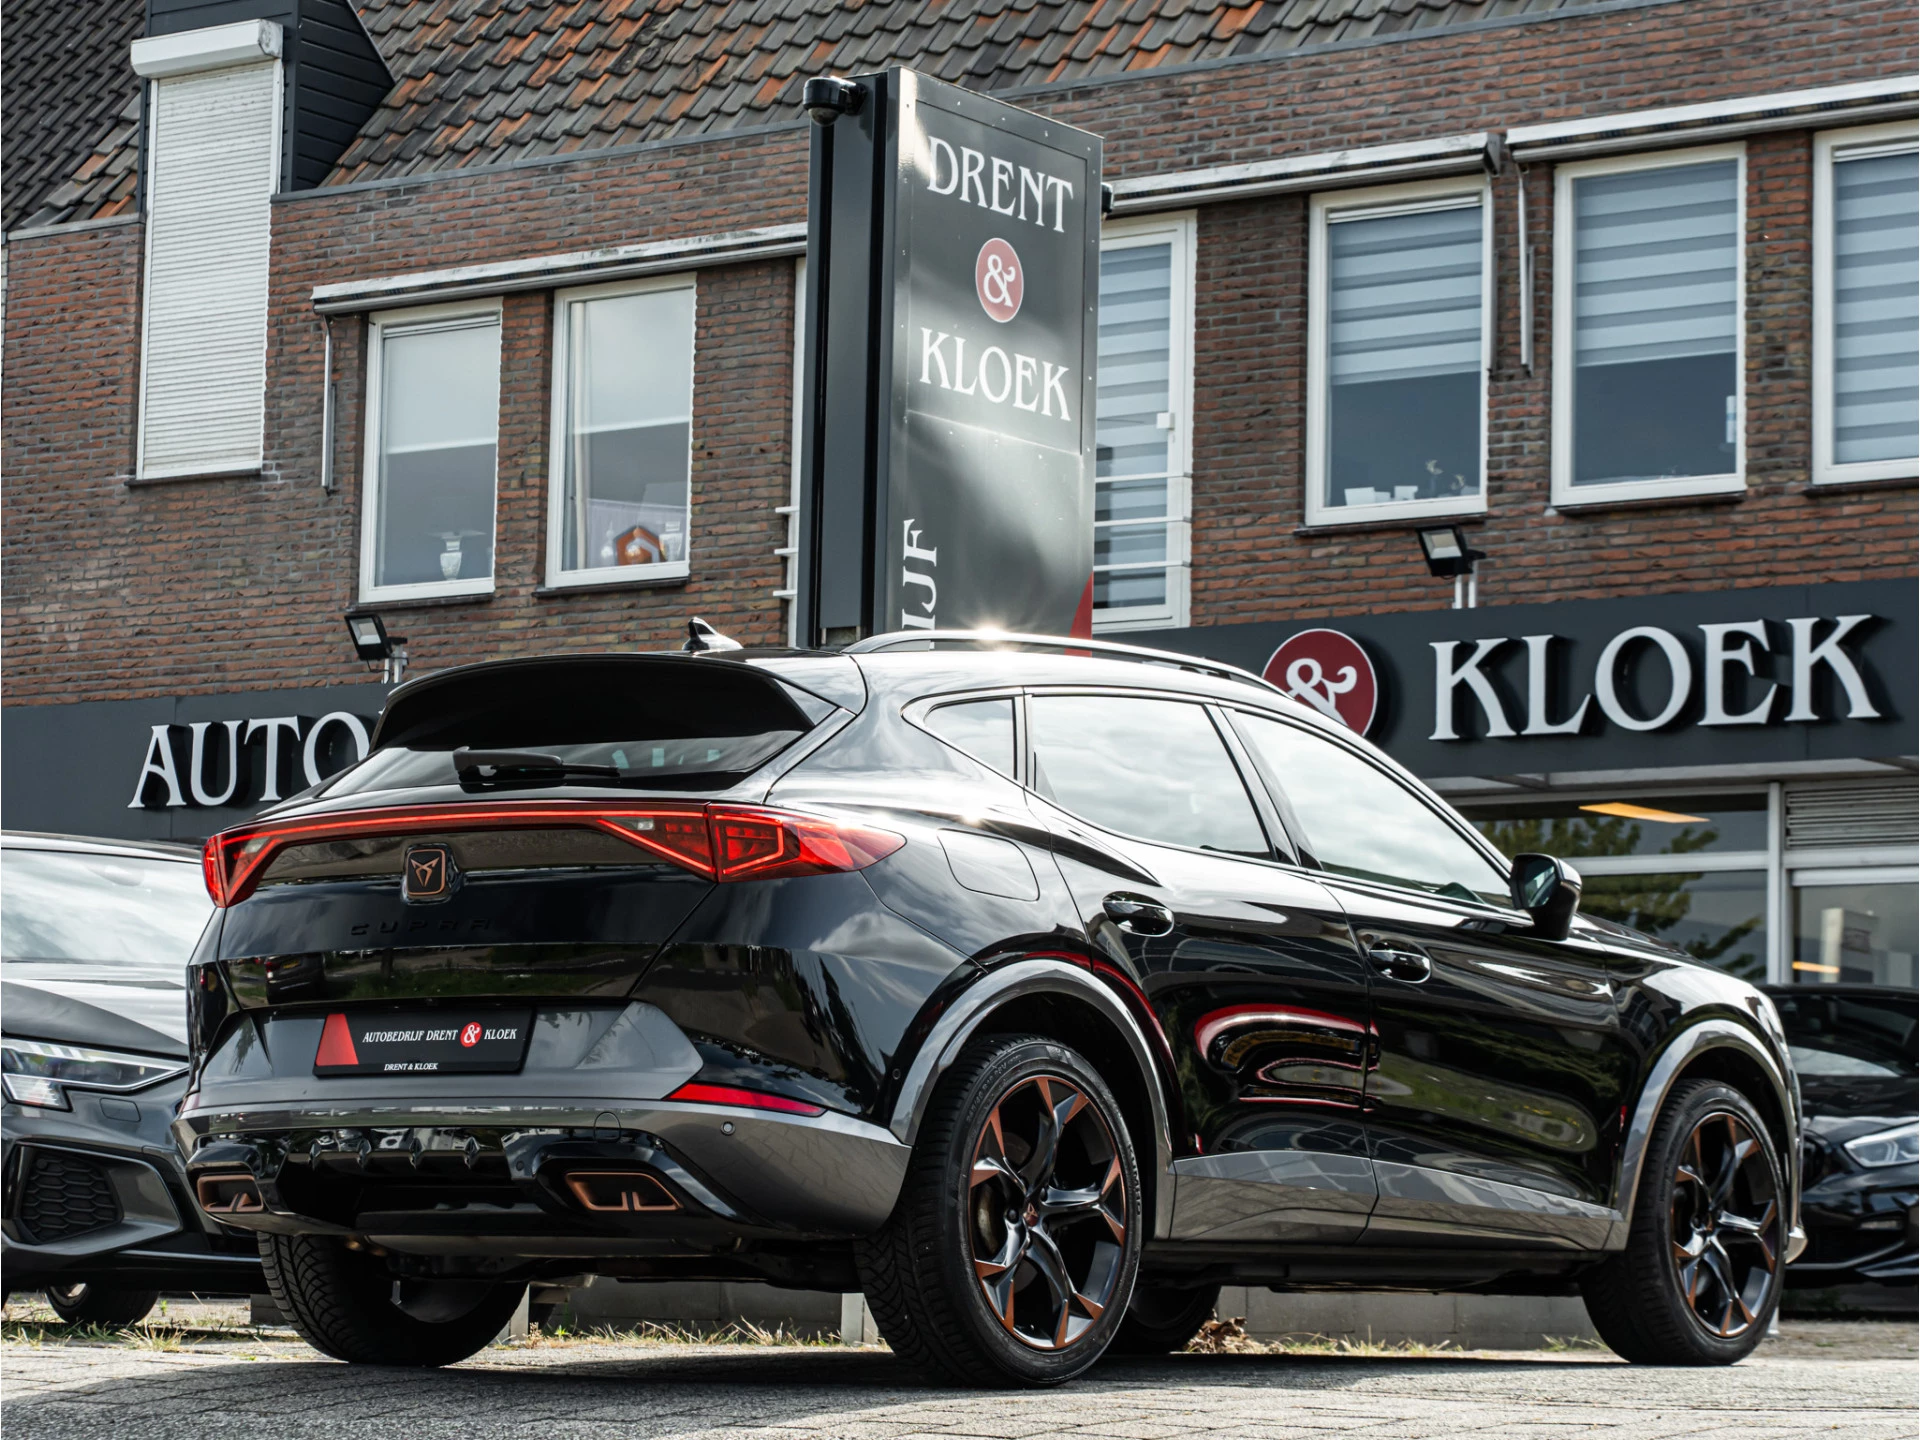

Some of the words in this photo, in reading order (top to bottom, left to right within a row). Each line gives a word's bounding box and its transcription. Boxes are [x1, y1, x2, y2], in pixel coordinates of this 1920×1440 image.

[926, 136, 1074, 233] DRENT
[984, 254, 1016, 308] &
[919, 327, 1072, 422] KLOEK
[1428, 614, 1882, 740] KLOEK
[127, 711, 371, 808] AUTO
[351, 918, 491, 936] CUPRA
[362, 1030, 425, 1043] AUTOBEDRIJF
[426, 1029, 458, 1041] DRENT
[463, 1024, 480, 1044] &
[484, 1028, 518, 1040] KLOEK
[384, 1063, 408, 1071] DRENT
[414, 1062, 438, 1070] KLOEK
